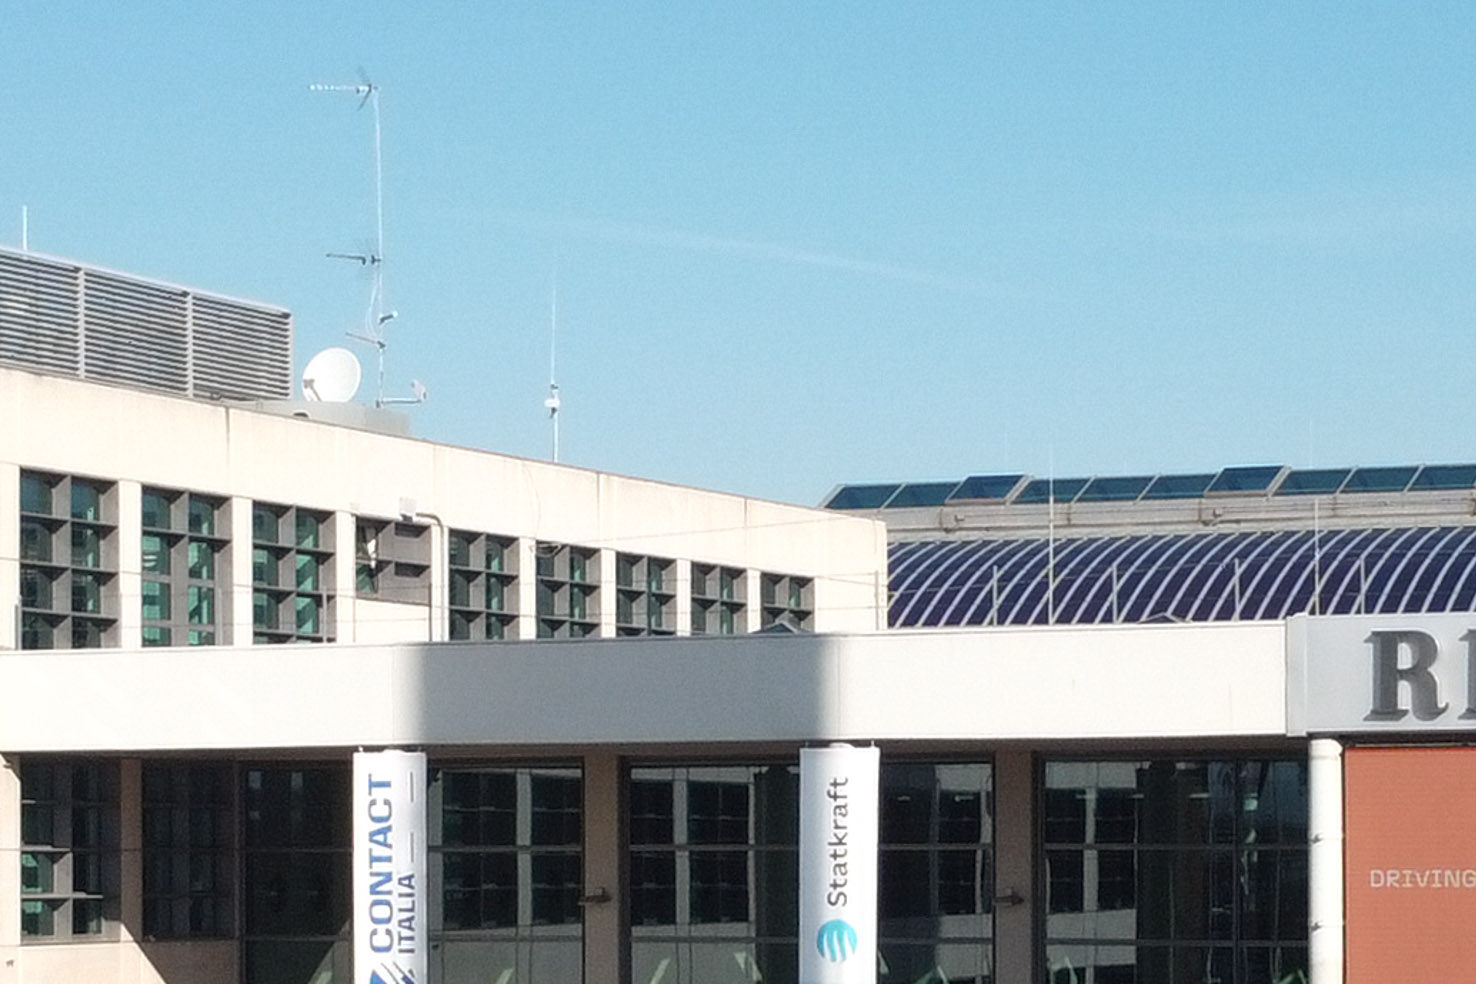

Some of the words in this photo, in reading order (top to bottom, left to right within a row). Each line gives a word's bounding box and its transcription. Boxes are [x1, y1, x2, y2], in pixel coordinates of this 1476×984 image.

[368, 773, 394, 954] CONTACT
[826, 777, 849, 907] Statkraft
[398, 873, 416, 954] ITALIA
